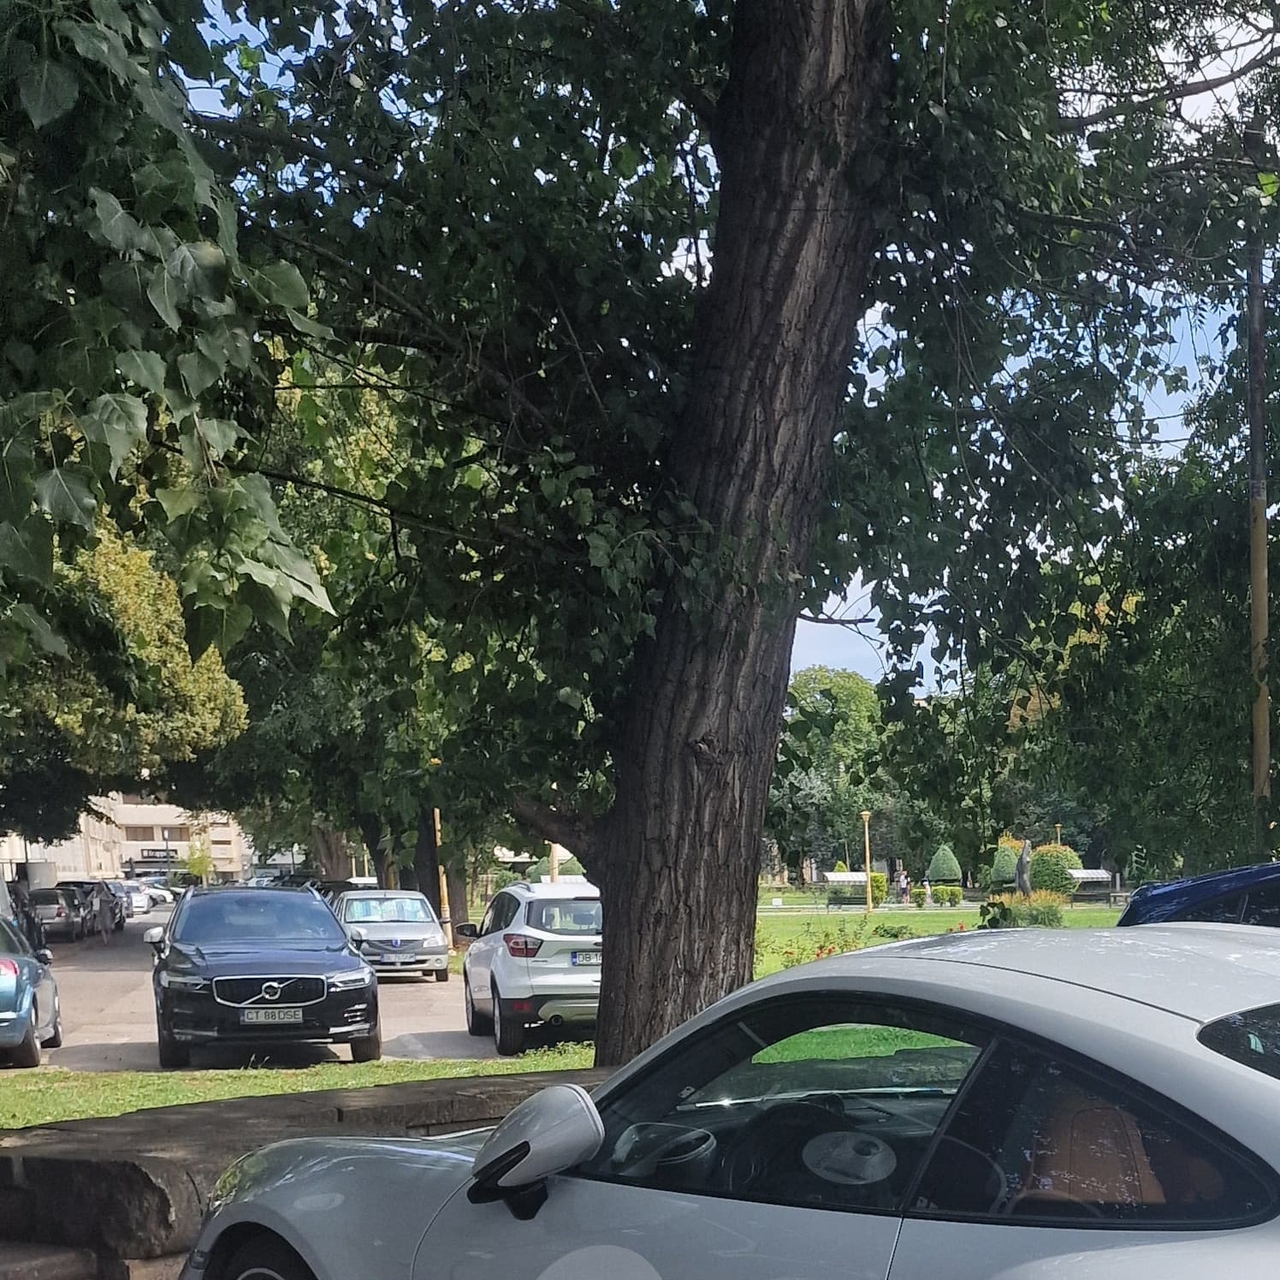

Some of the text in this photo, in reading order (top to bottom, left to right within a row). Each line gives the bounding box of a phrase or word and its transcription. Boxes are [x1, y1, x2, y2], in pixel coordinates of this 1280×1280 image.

[577, 953, 592, 963] DB
[246, 1010, 260, 1021] CT
[278, 1010, 301, 1020] DSE
